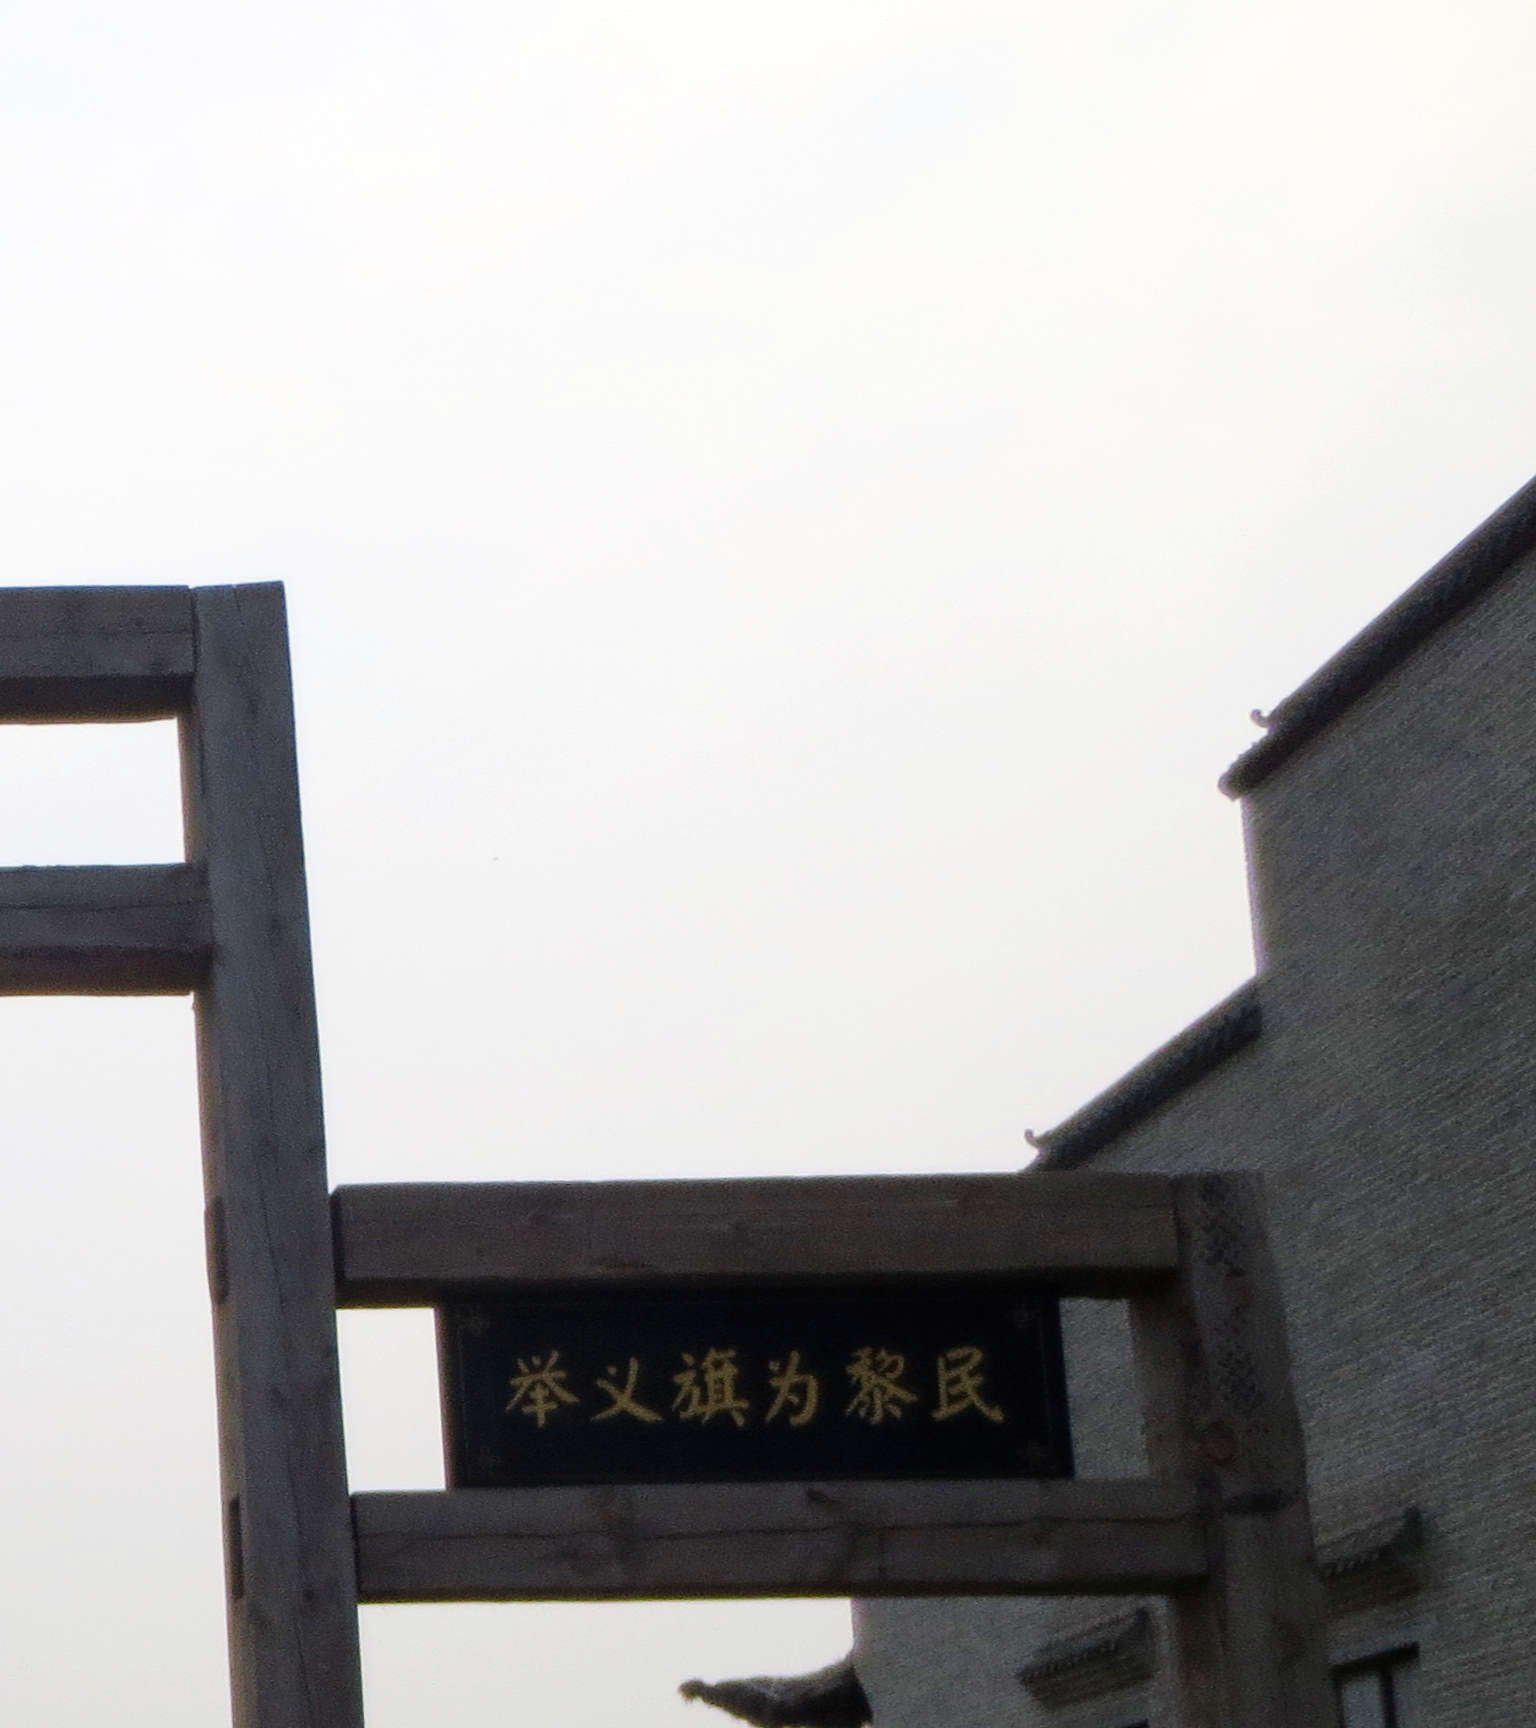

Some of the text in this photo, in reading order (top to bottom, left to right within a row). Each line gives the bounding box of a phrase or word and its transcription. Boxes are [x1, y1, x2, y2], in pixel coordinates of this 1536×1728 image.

[505, 1347, 1005, 1427] 举义旗为黎民
